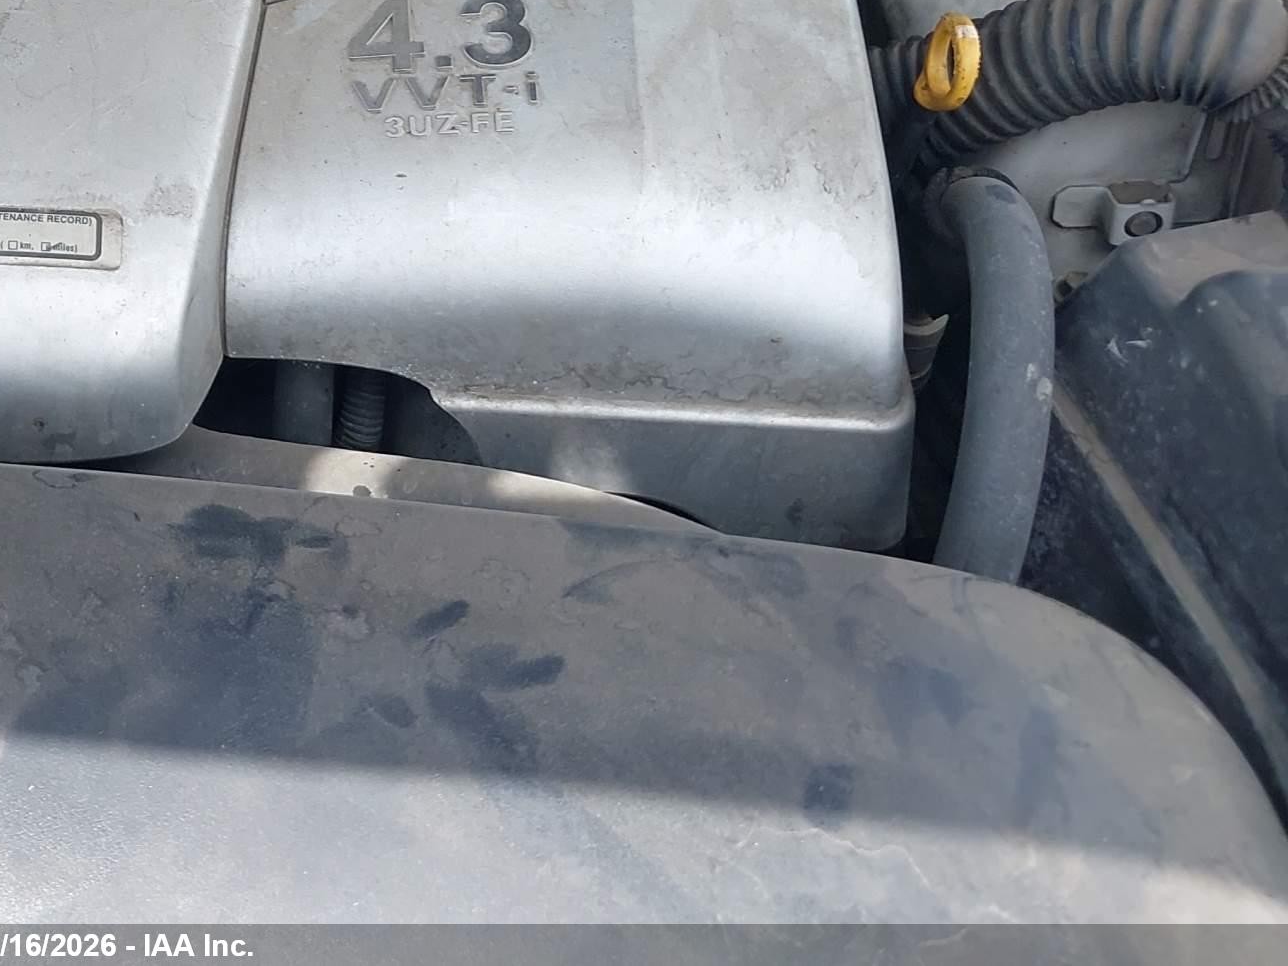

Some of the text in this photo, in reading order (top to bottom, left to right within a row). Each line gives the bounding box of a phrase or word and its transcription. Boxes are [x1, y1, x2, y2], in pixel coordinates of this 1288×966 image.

[352, 71, 542, 114] VVT-i
[384, 110, 515, 138] 3UZ-FE
[46, 214, 93, 227] RECORD)
